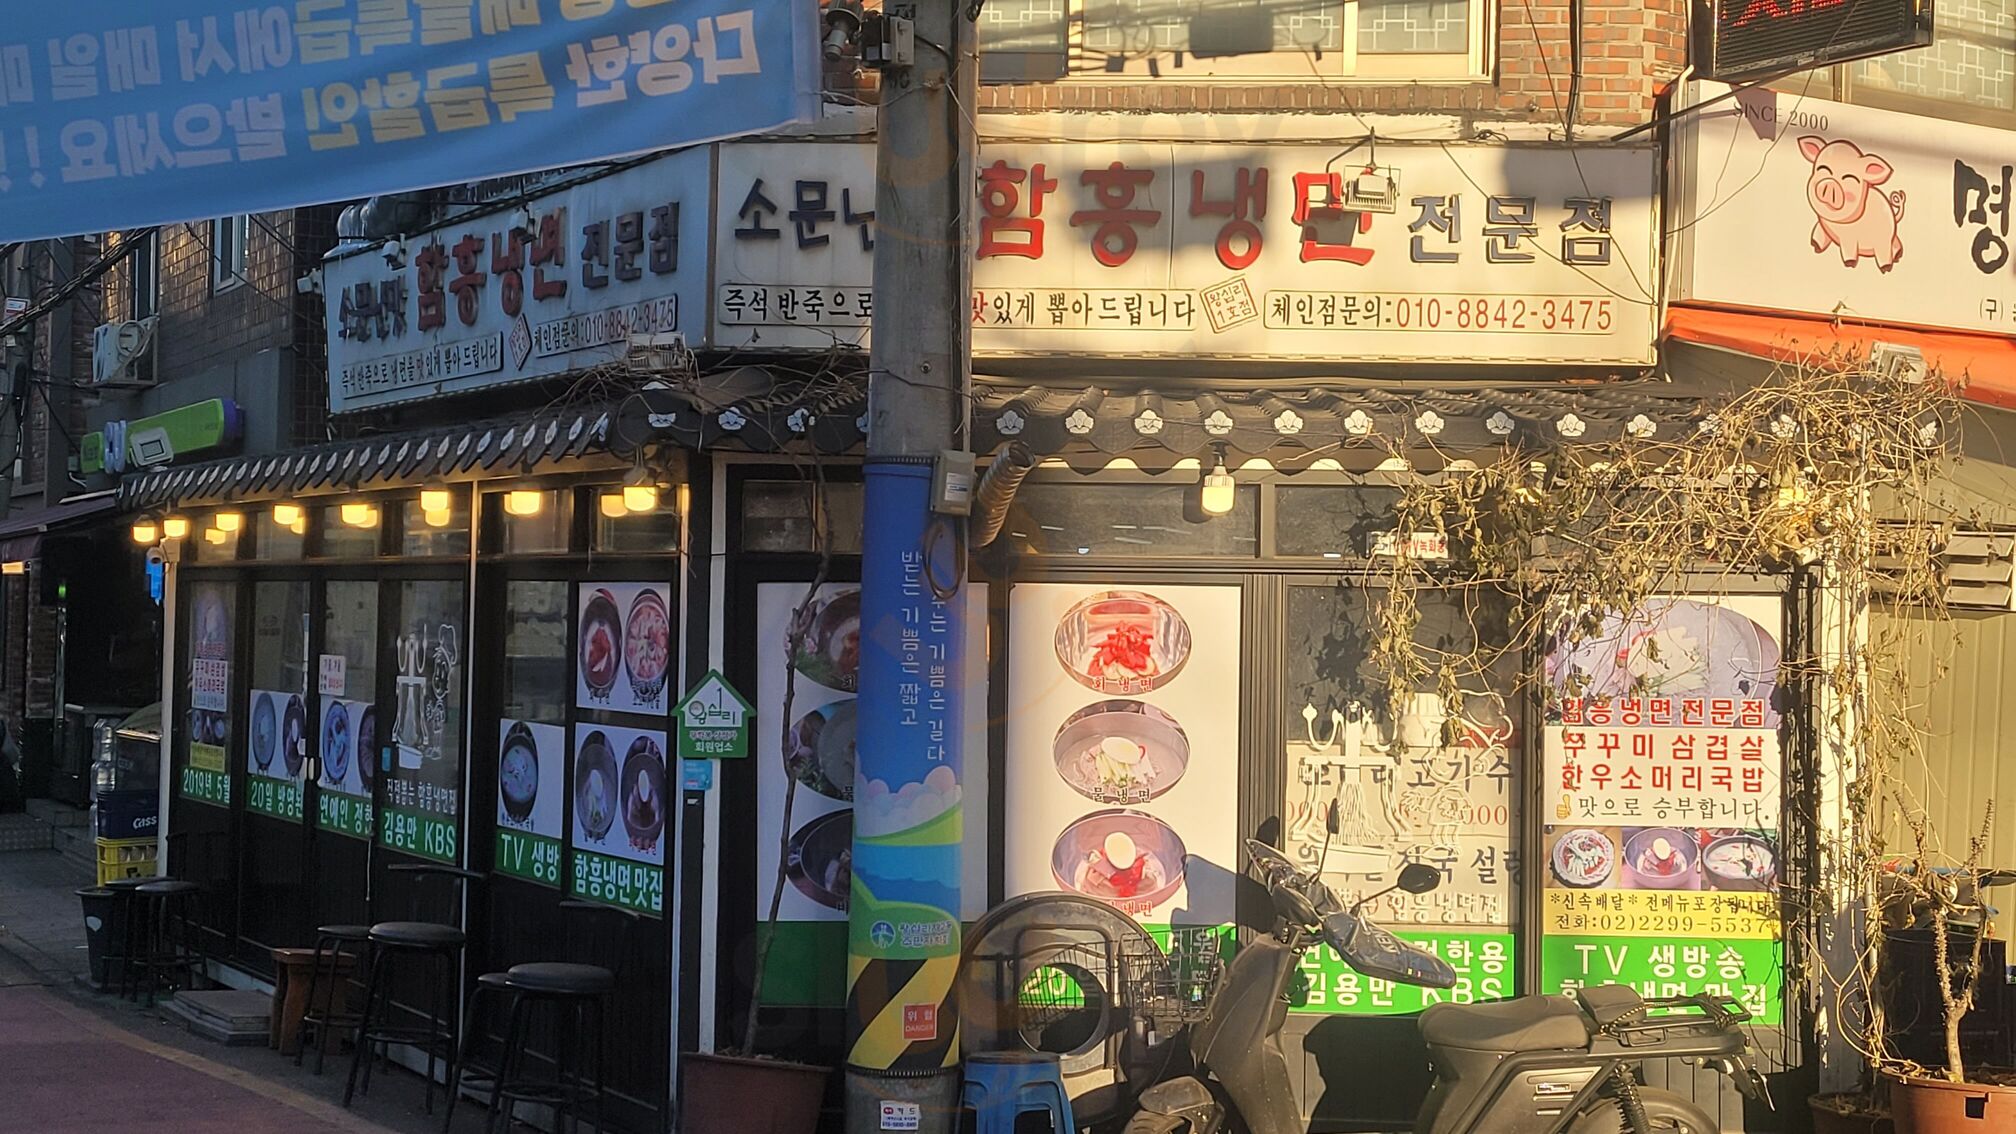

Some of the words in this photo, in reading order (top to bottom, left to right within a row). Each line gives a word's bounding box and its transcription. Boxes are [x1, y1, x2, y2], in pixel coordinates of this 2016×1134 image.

[1790, 110, 1829, 131] 2000
[975, 159, 1375, 270] 함흥냉면
[1408, 194, 1612, 266] 전문점
[416, 207, 568, 331] 함흥냉면
[582, 202, 679, 289] 전문점
[723, 289, 768, 322] 즉석
[777, 288, 872, 322] 반죽으로
[972, 291, 1035, 325] 맛있게
[1209, 282, 1247, 307] 왕십리
[1217, 299, 1252, 323] 1호점
[901, 551, 922, 596] 받는
[900, 607, 920, 674] 기쁨은
[928, 643, 946, 711] 기쁨은
[689, 687, 735, 725] 왕십리
[899, 683, 921, 725] 짧고
[927, 719, 946, 761] 길다
[1671, 734, 1765, 762] 삼겹살
[183, 768, 212, 799] 2019년
[250, 780, 273, 812] 20일
[133, 815, 157, 829] Cass
[319, 793, 349, 829] 연예인
[1578, 796, 1642, 818] 맛으로
[1652, 797, 1770, 821] 승부합니다.
[384, 811, 418, 850] 김용만
[424, 821, 456, 859] KBS
[501, 833, 525, 871] TV
[531, 841, 560, 882] 생방
[575, 853, 632, 901] 함흥냉면
[634, 867, 664, 912] 맛집
[1574, 944, 1629, 976] TV
[1647, 944, 1746, 980] 생방송
[1307, 973, 1396, 1006] 김용만
